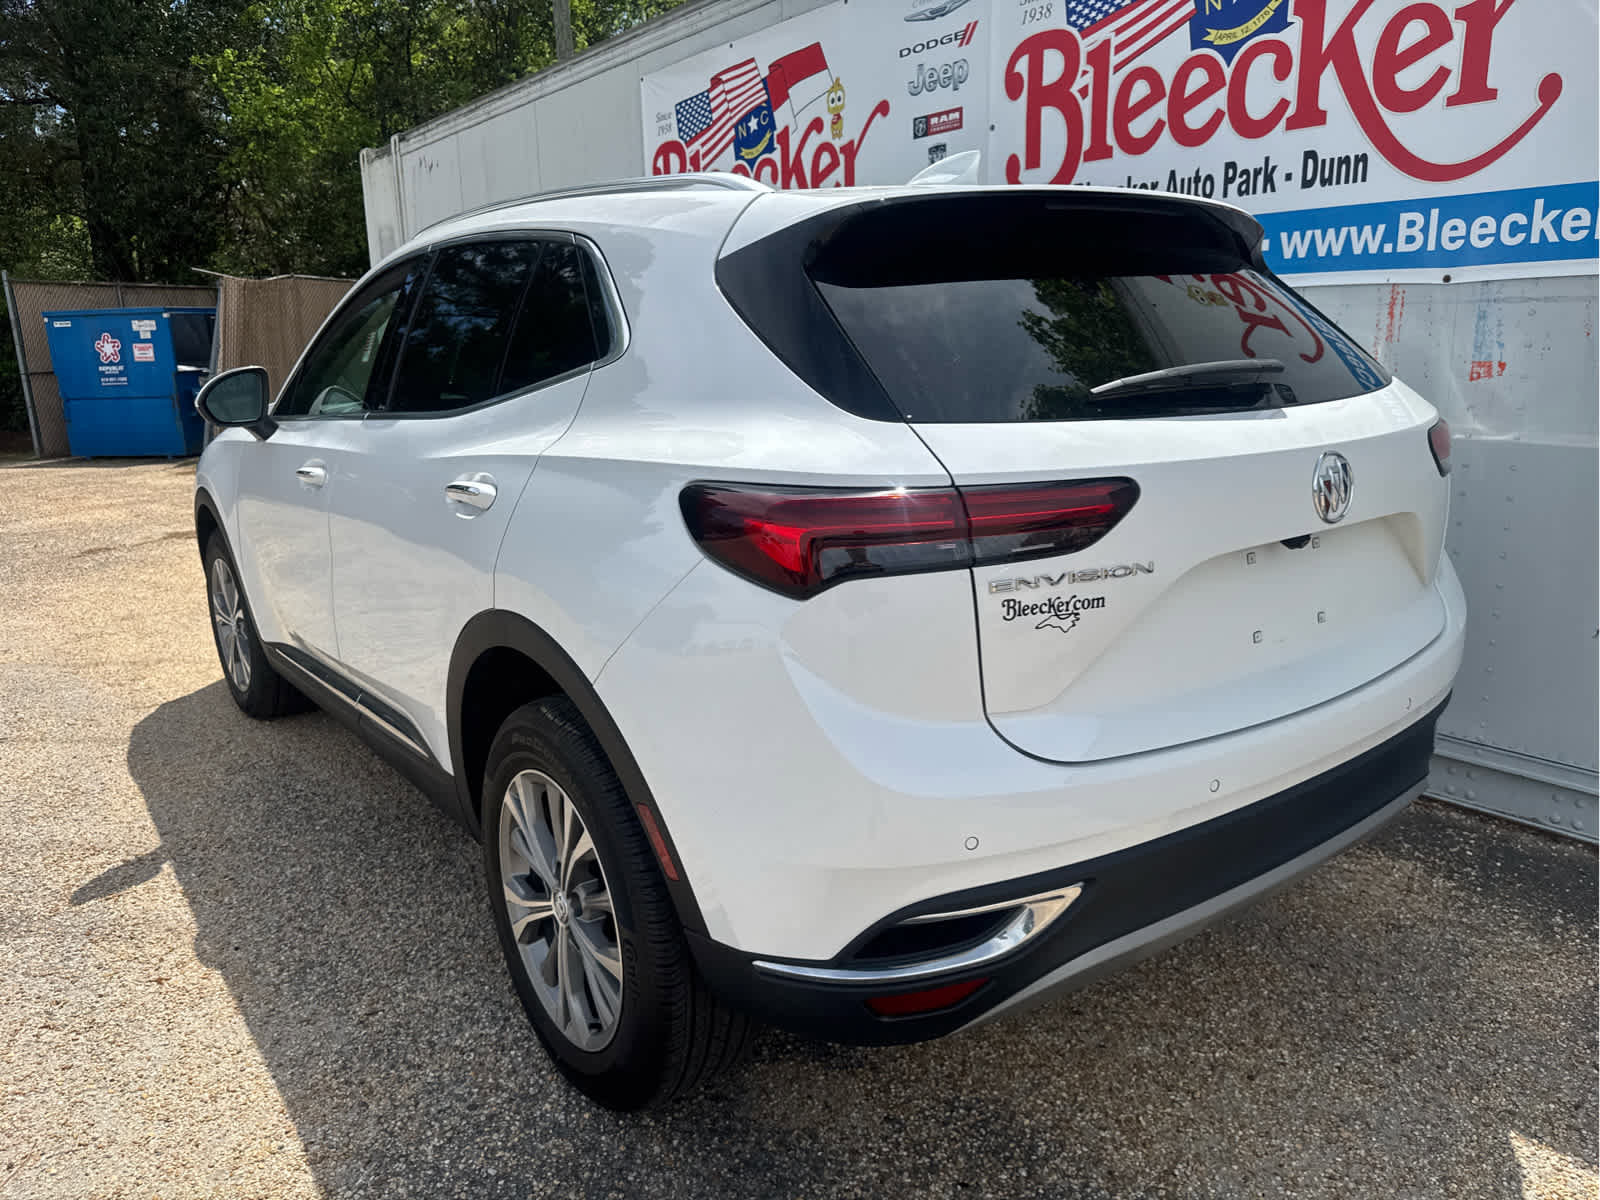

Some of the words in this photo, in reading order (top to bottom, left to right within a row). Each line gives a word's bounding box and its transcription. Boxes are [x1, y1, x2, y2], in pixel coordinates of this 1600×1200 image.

[1022, 2, 1053, 25] 1938
[899, 28, 968, 58] DODGE
[907, 58, 969, 96] Jeep
[930, 111, 960, 125] RAM
[1223, 156, 1278, 199] Park
[1301, 150, 1368, 189] Dunn
[1280, 198, 1599, 260] www.Bleecke
[989, 561, 1154, 594] ENVISION
